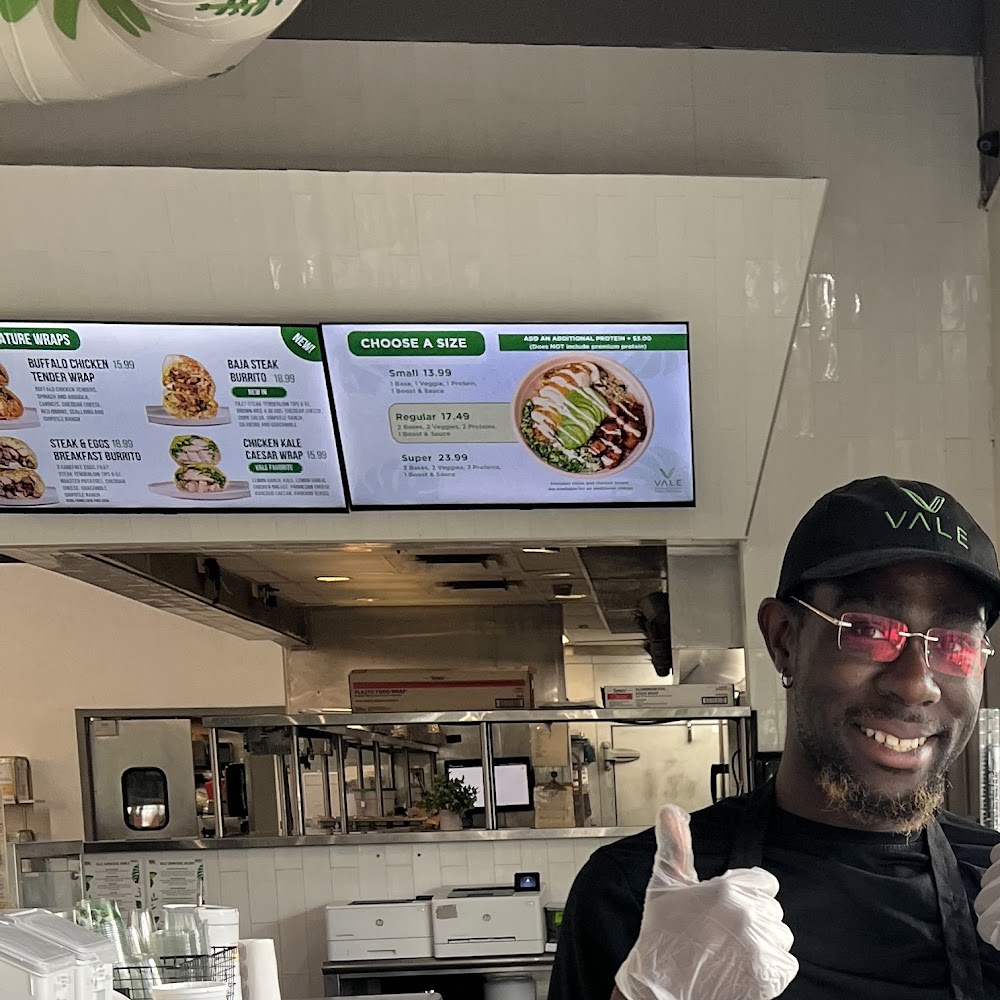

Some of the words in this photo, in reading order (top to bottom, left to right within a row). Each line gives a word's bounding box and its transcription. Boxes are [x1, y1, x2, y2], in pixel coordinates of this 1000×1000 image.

[33, 333, 71, 346] WRAPS
[292, 332, 316, 354] NEW!
[360, 338, 419, 349] CHOOSE
[423, 338, 433, 348] A
[437, 338, 468, 348] SIZE
[27, 358, 68, 369] BUFFALO
[69, 358, 110, 370] CHICKEN
[112, 360, 135, 370] 15.99
[228, 360, 250, 370] BAJA
[251, 360, 279, 370] STEAK
[30, 371, 68, 383] TENDER
[68, 372, 95, 384] WRAP
[230, 372, 267, 383] BURRITO
[274, 374, 296, 384] 18.99
[388, 368, 418, 378] Small
[423, 368, 452, 377] 13.99
[395, 412, 436, 422] Regular
[441, 412, 470, 421] 17.49
[50, 438, 78, 449] STEAK
[80, 439, 86, 449] &
[88, 439, 110, 449] EGGS
[112, 439, 134, 449] 18.99
[243, 438, 279, 448] CHICKEN
[280, 438, 302, 448] KALE
[53, 452, 104, 462] BREAKFAST
[105, 452, 142, 462] BURRITO
[246, 450, 278, 460] CAESAR
[280, 451, 304, 460] WRAP
[306, 450, 328, 460] 15.99
[402, 454, 432, 463] Super
[438, 454, 468, 462] 23.99
[884, 510, 969, 550] VALE
